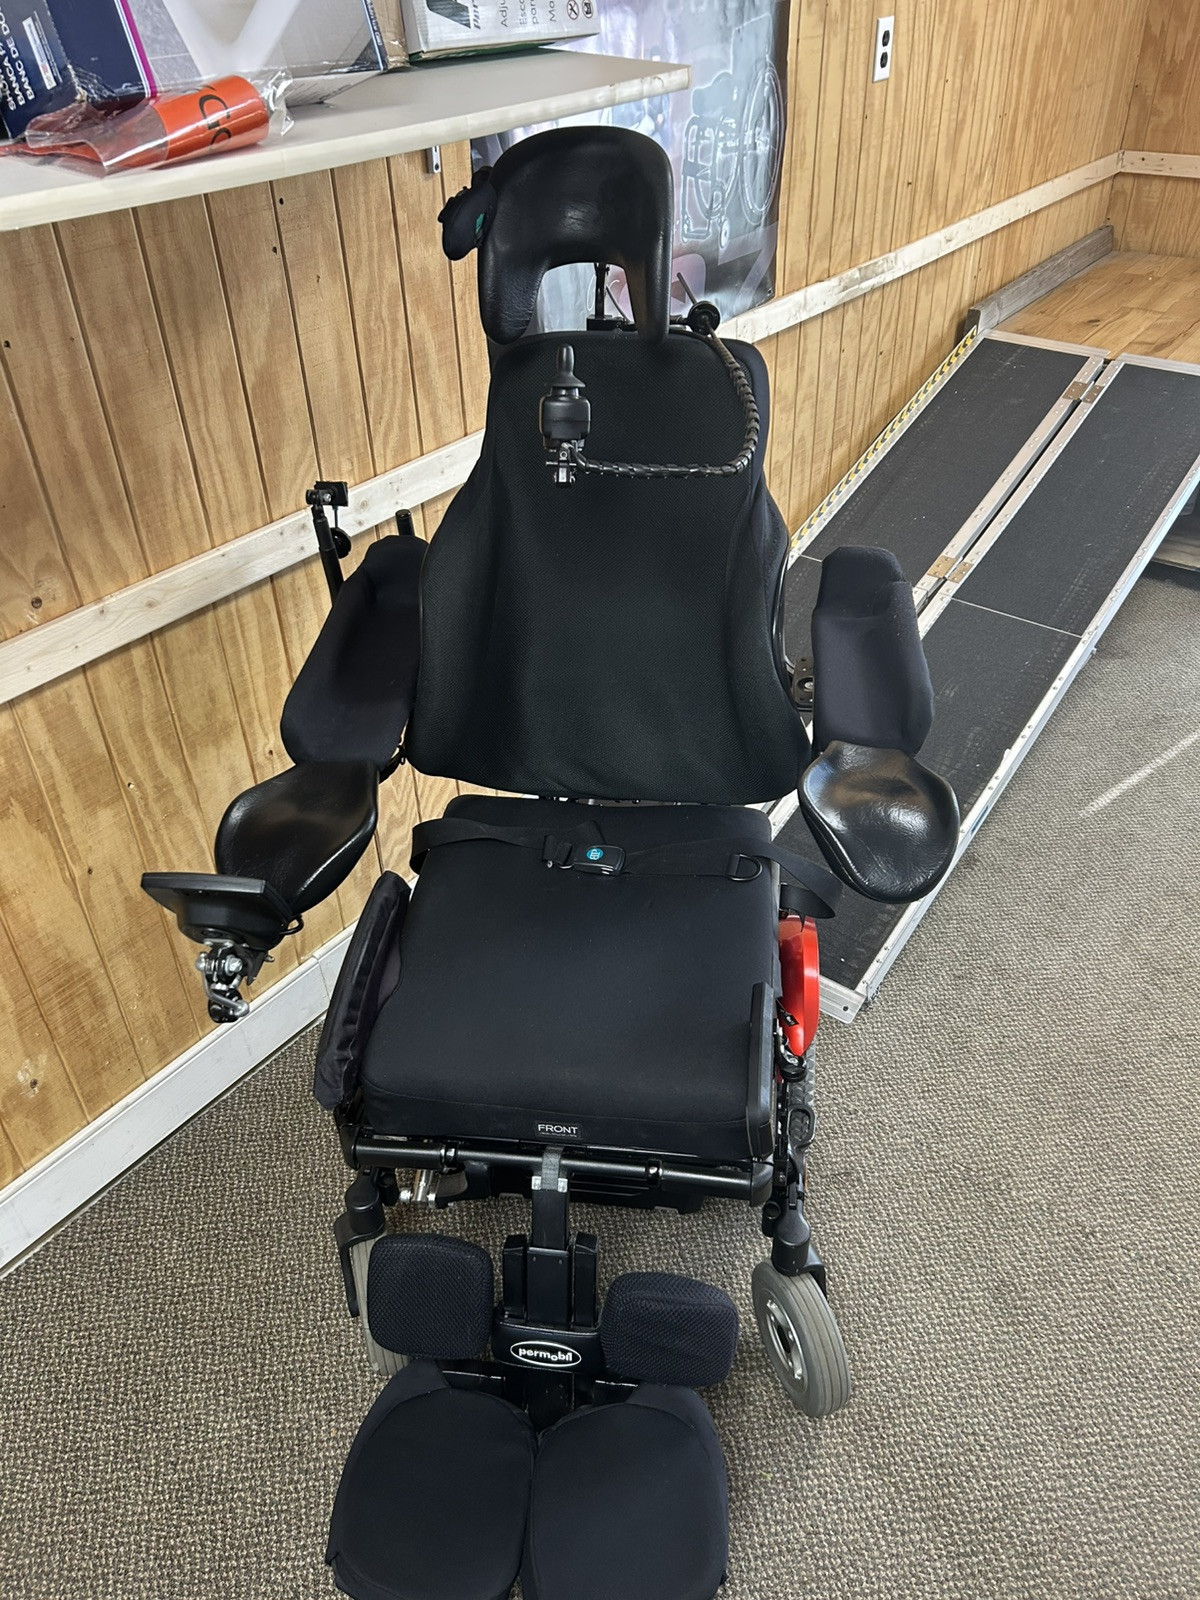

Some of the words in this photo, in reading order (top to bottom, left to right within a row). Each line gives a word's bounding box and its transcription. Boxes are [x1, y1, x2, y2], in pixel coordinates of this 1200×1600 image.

[530, 0, 540, 25] par
[6, 36, 20, 59] DE
[3, 56, 26, 106] BANCA
[15, 59, 36, 101] BANC
[537, 1123, 578, 1134] FRONT
[518, 1347, 573, 1362] permobil
